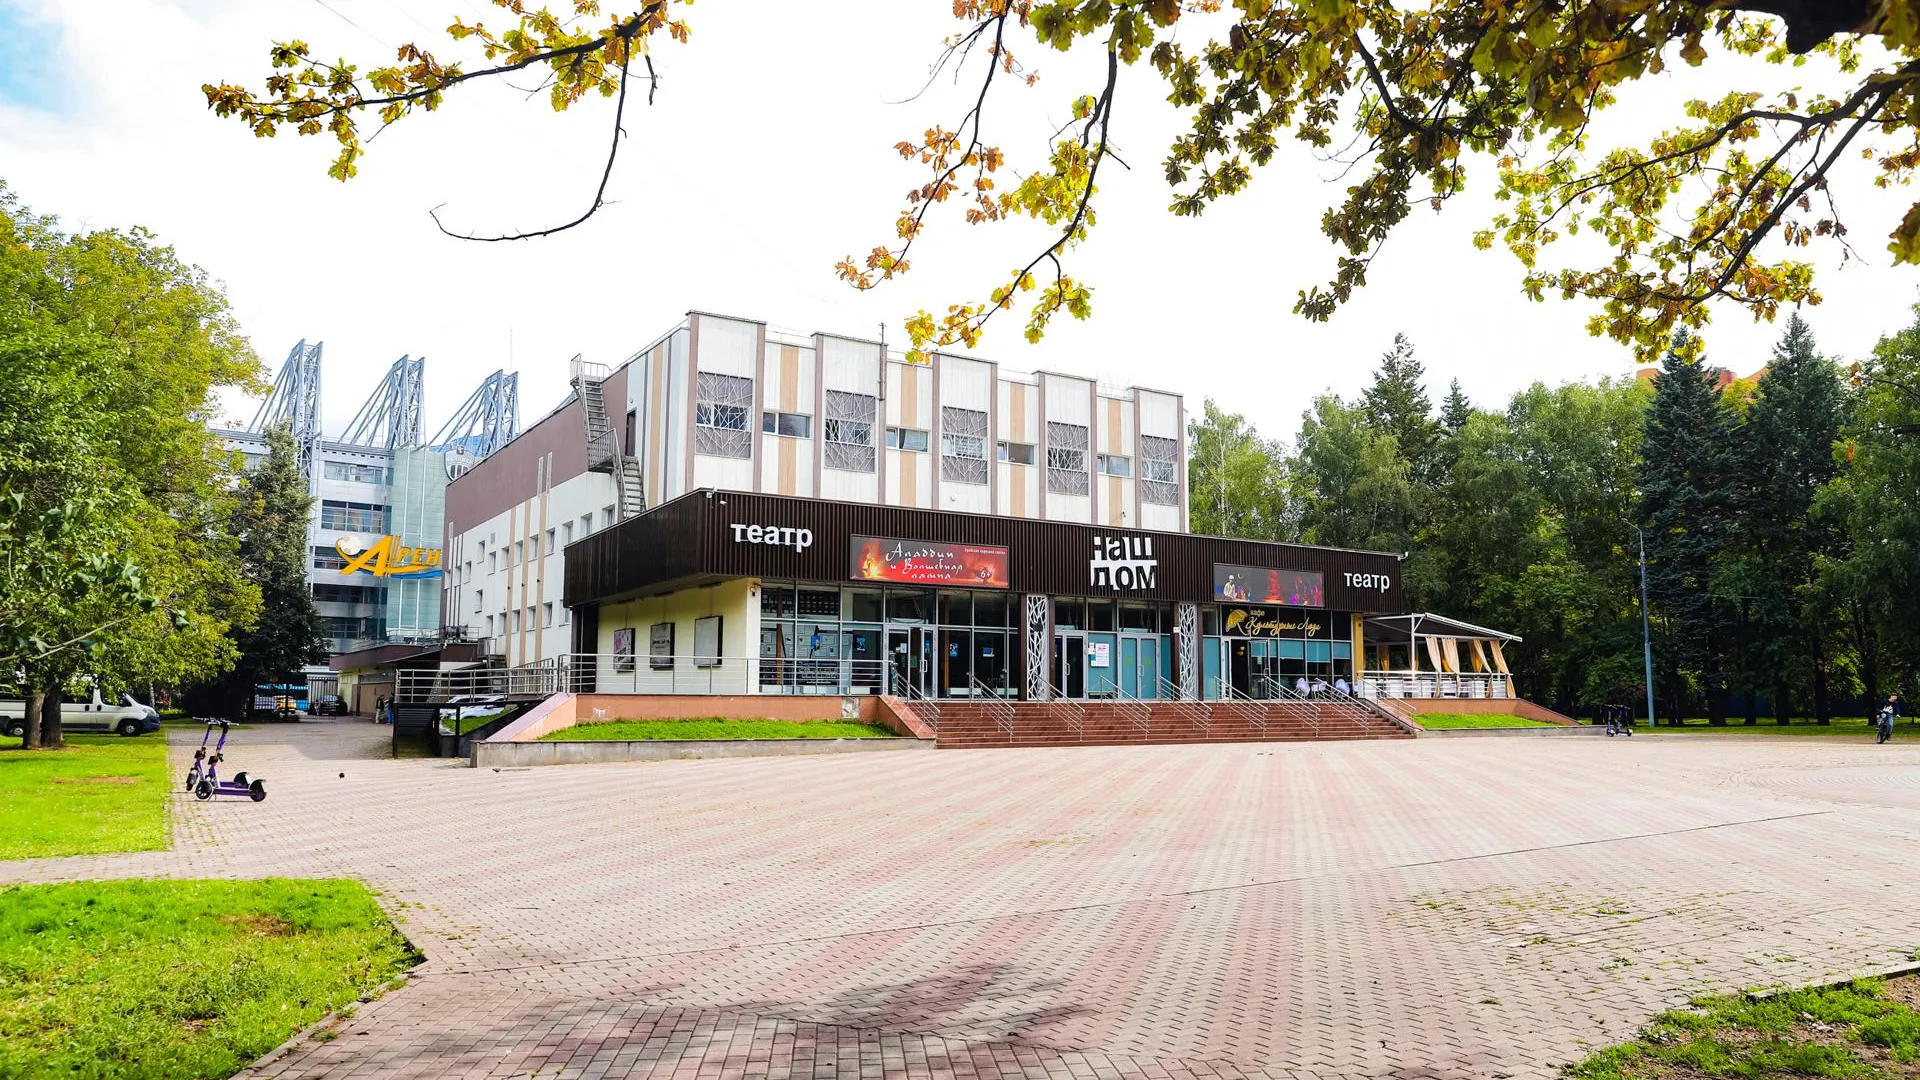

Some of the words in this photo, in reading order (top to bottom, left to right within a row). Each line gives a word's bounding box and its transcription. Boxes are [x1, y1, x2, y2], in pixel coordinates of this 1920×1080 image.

[730, 523, 813, 553] театр
[336, 534, 442, 577] АРЕН
[885, 541, 954, 561] Аладдин
[902, 558, 963, 575] Волшебная
[980, 570, 990, 579] 6+
[1343, 572, 1390, 593] театр
